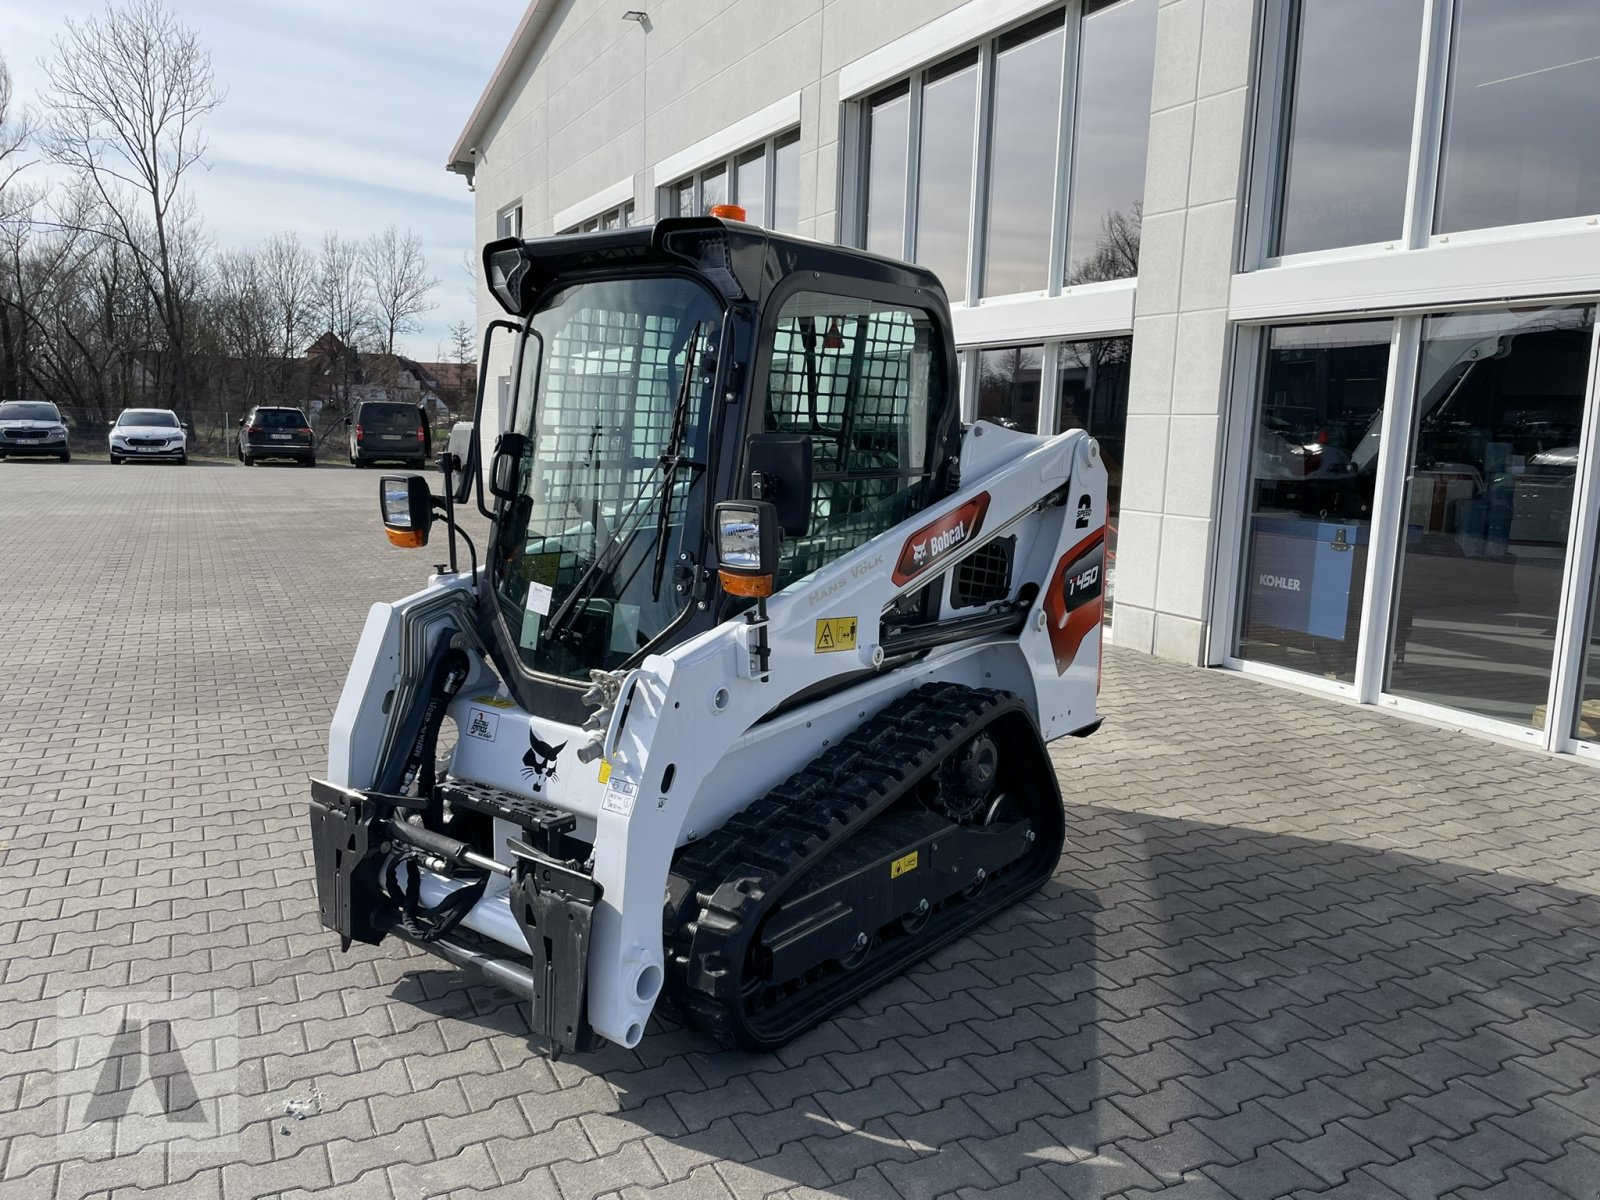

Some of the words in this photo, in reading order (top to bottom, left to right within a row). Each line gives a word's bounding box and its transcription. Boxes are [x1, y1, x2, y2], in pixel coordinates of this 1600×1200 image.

[1075, 494, 1091, 529] 2
[1076, 508, 1092, 518] SPEED
[930, 520, 965, 556] Bobcat
[1069, 565, 1099, 596] T450
[1259, 573, 1301, 592] KOHLER
